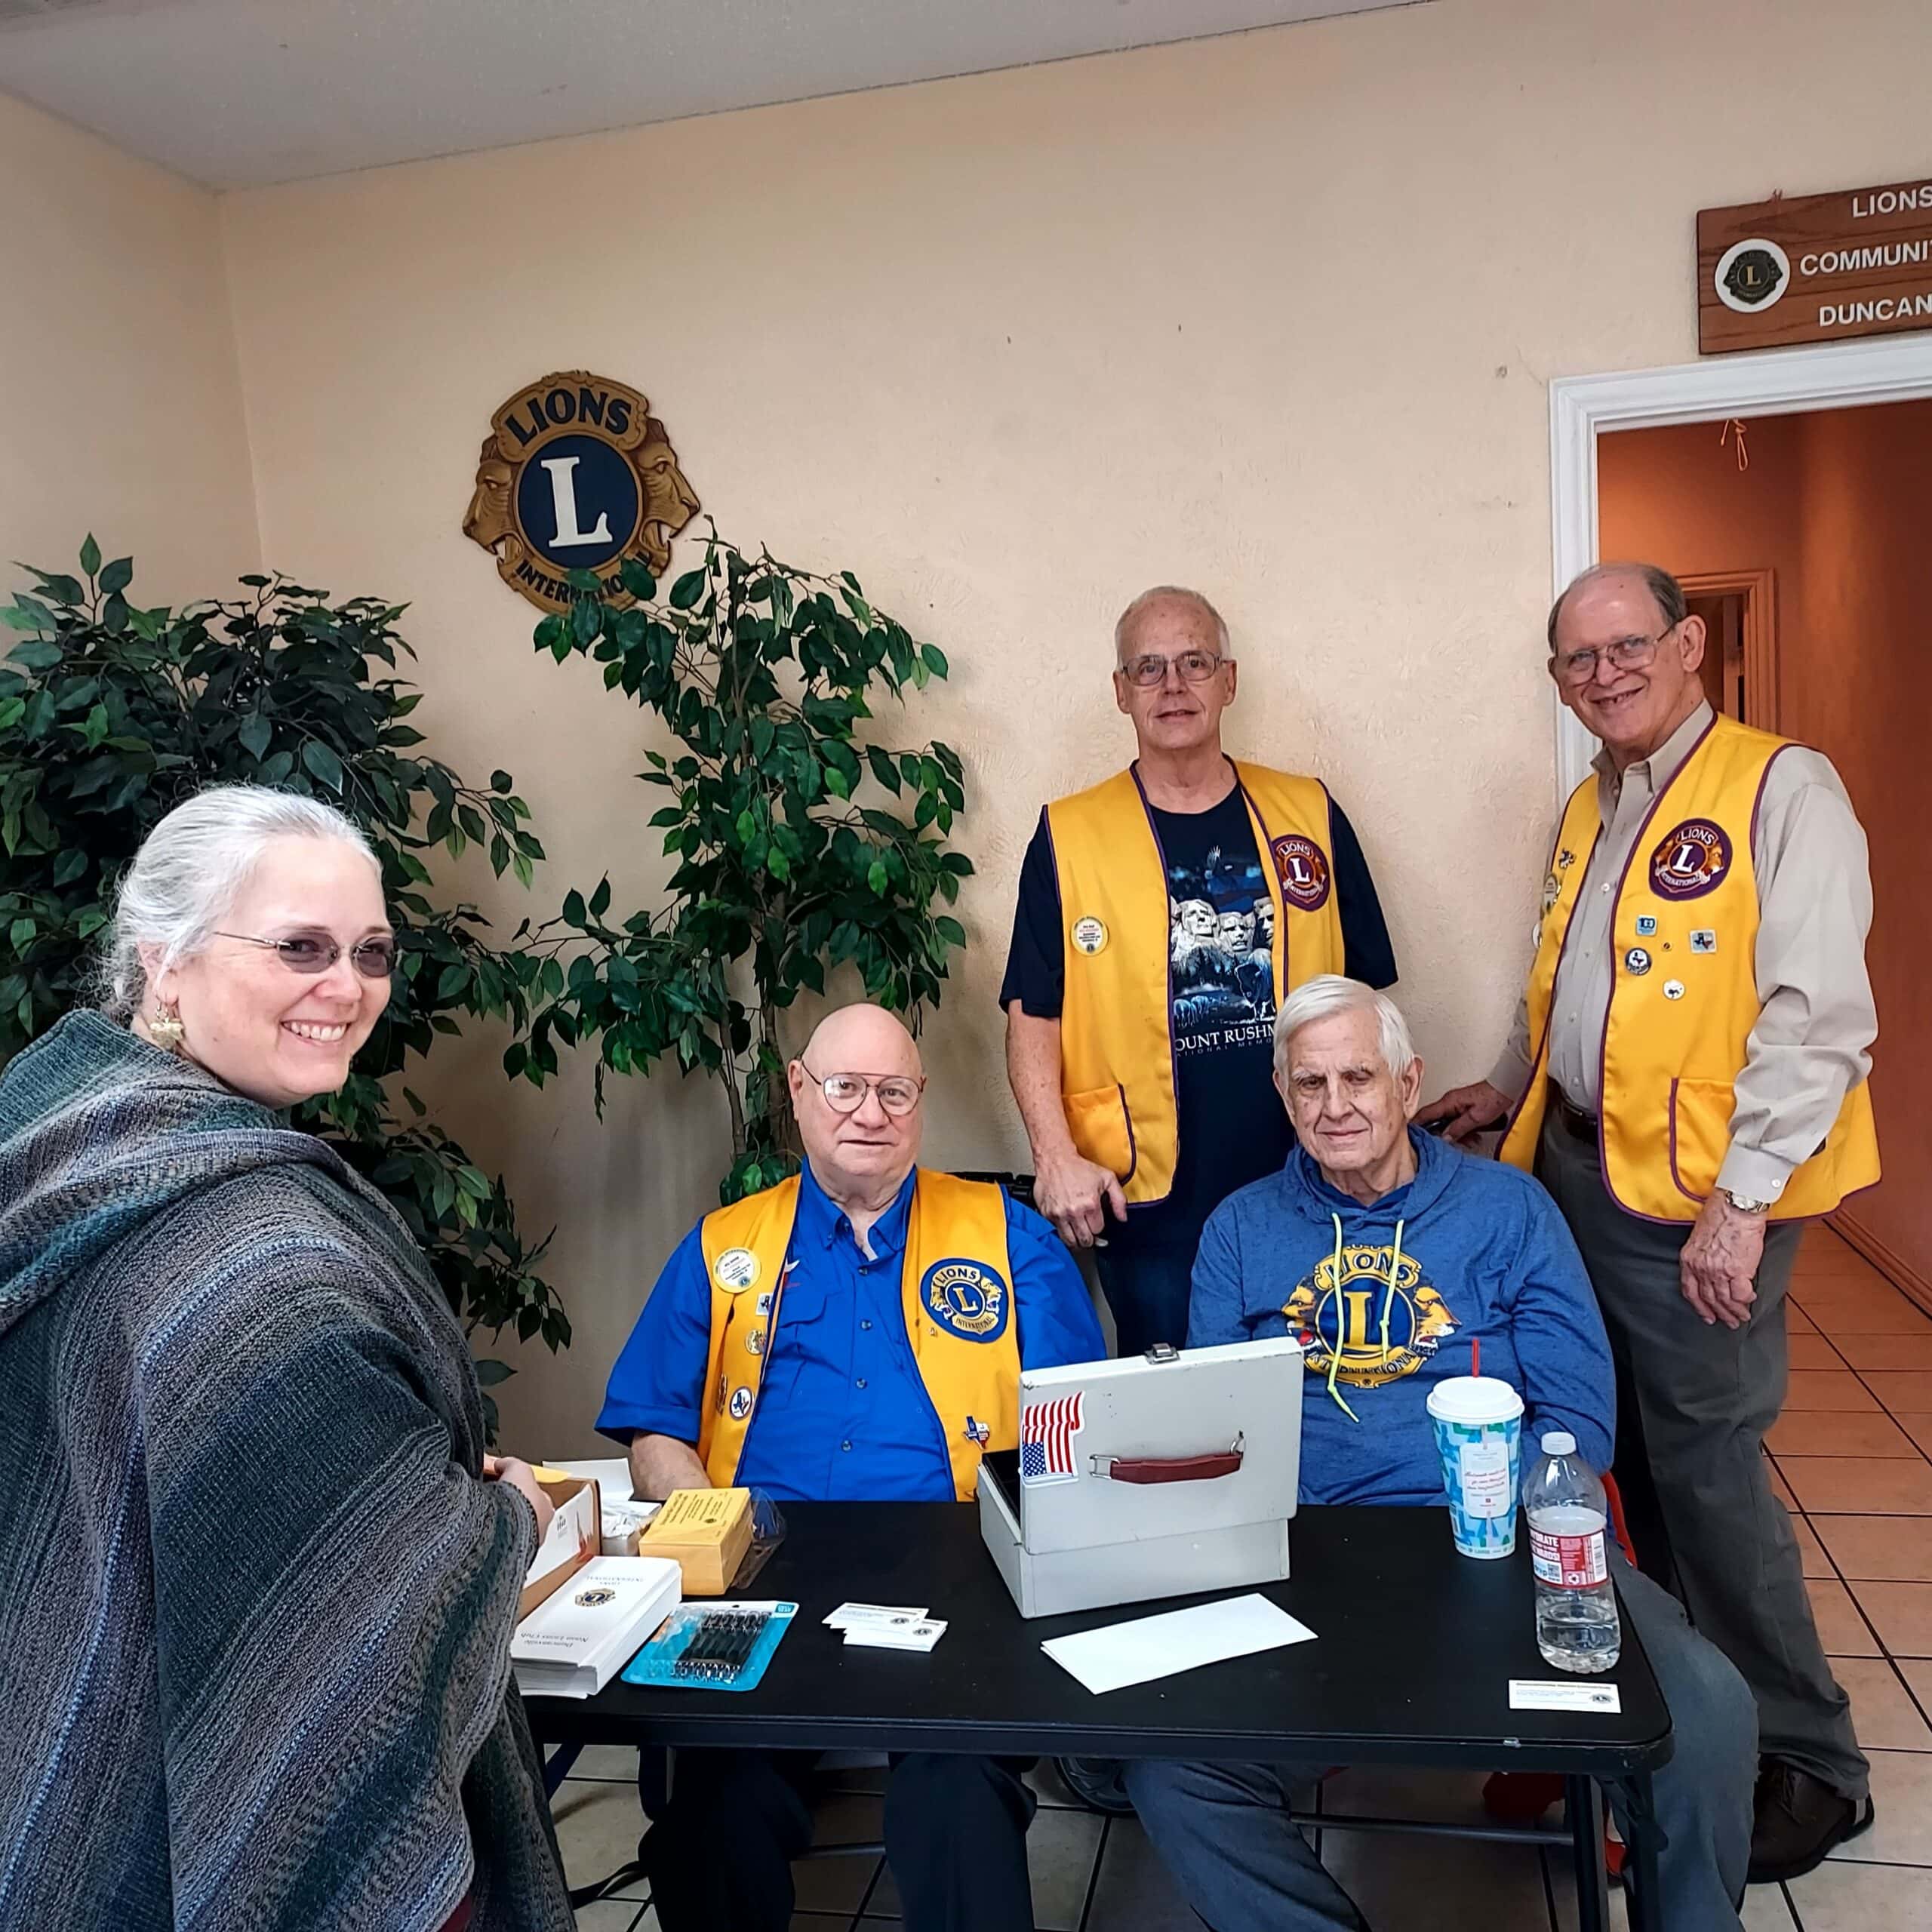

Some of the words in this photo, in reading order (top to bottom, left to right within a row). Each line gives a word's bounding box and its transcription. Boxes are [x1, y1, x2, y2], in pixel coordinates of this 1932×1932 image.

[1853, 186, 1932, 218] LIONS
[1799, 239, 1932, 276] COMMUNI
[1746, 265, 1761, 286] L
[1819, 294, 1932, 327] DUNCAN
[504, 387, 632, 446] LIONS
[540, 457, 613, 548] L
[1279, 841, 1311, 856] LIONS
[1680, 828, 1715, 845] LIONS
[1289, 858, 1310, 882] L
[1672, 844, 1695, 873] L
[1175, 1032, 1220, 1051] OUNT
[935, 1268, 977, 1284] LIONS
[952, 1287, 979, 1312] L
